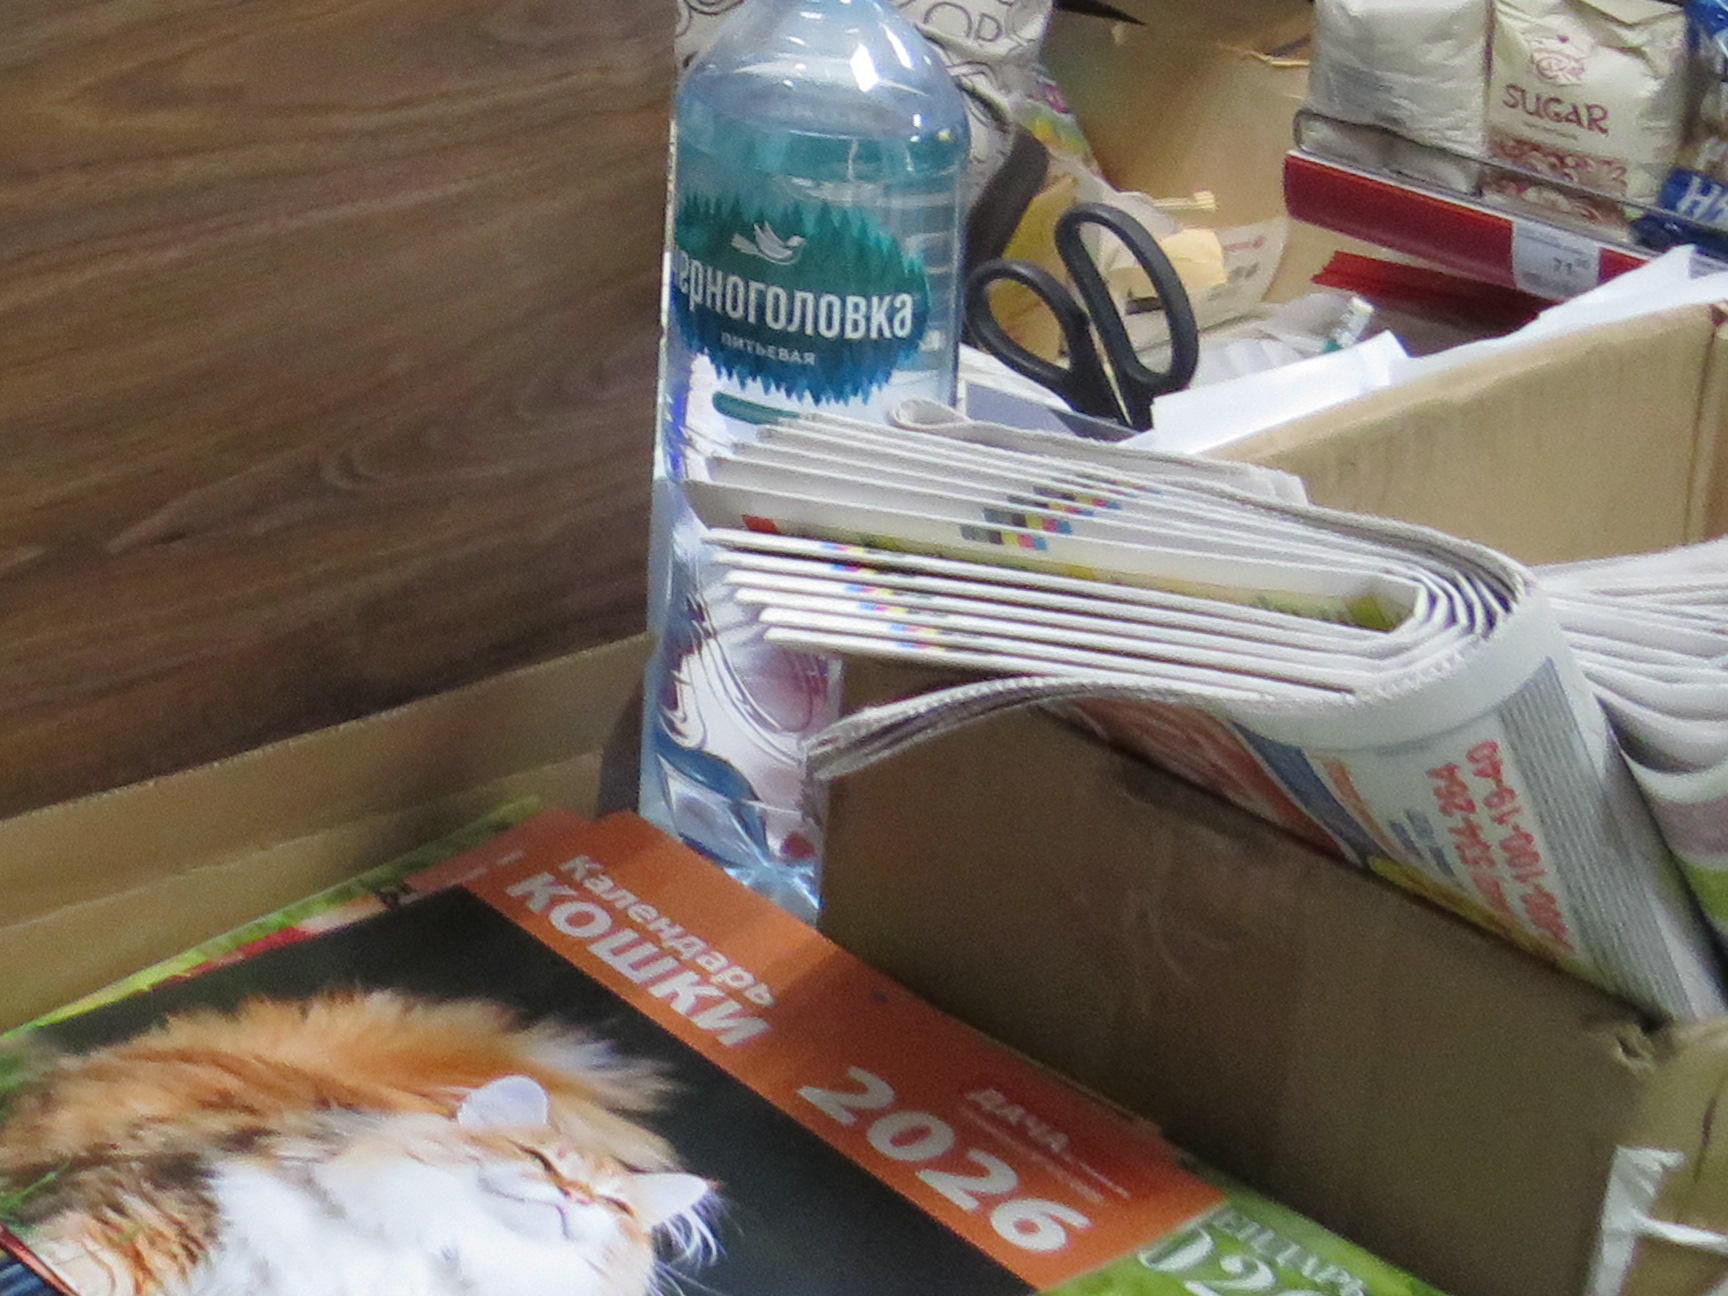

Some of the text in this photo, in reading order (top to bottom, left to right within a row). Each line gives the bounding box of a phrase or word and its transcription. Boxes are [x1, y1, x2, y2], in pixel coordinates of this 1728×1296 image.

[1501, 81, 1610, 136] SUGAR
[677, 249, 914, 342] ерноголовка
[719, 329, 817, 368] ПИТЬЕВАЯ
[505, 872, 773, 1050] КОШКИ
[557, 851, 777, 1008] Календарь
[796, 1063, 1094, 1254] 2026
